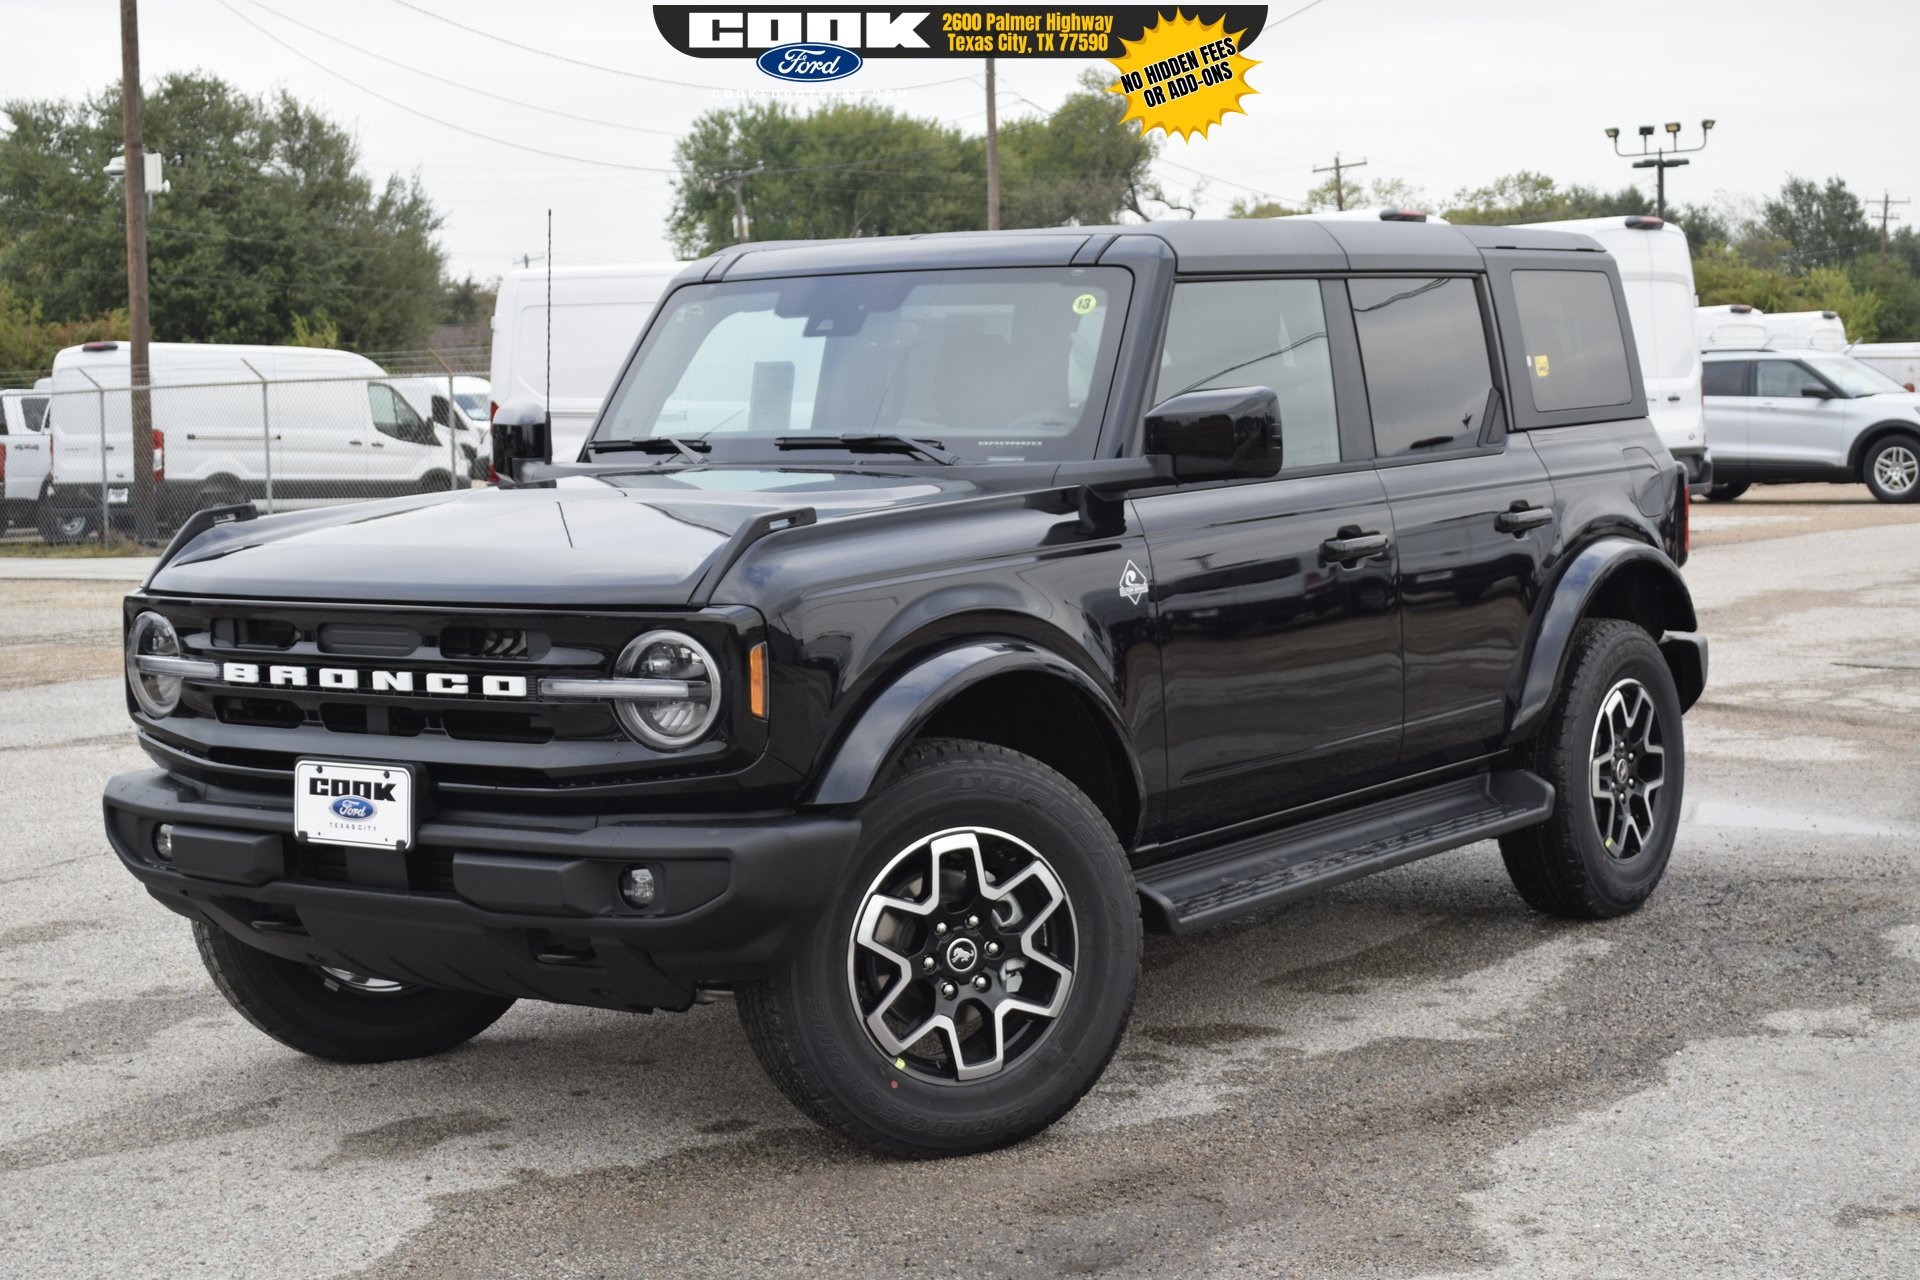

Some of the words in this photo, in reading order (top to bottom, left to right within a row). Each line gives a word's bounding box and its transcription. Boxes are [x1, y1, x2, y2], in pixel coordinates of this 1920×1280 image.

[223, 662, 527, 697] BRONCO
[309, 777, 397, 802] COOK
[339, 799, 367, 817] Ford
[806, 998, 1027, 1138] BRIDGESTONE
